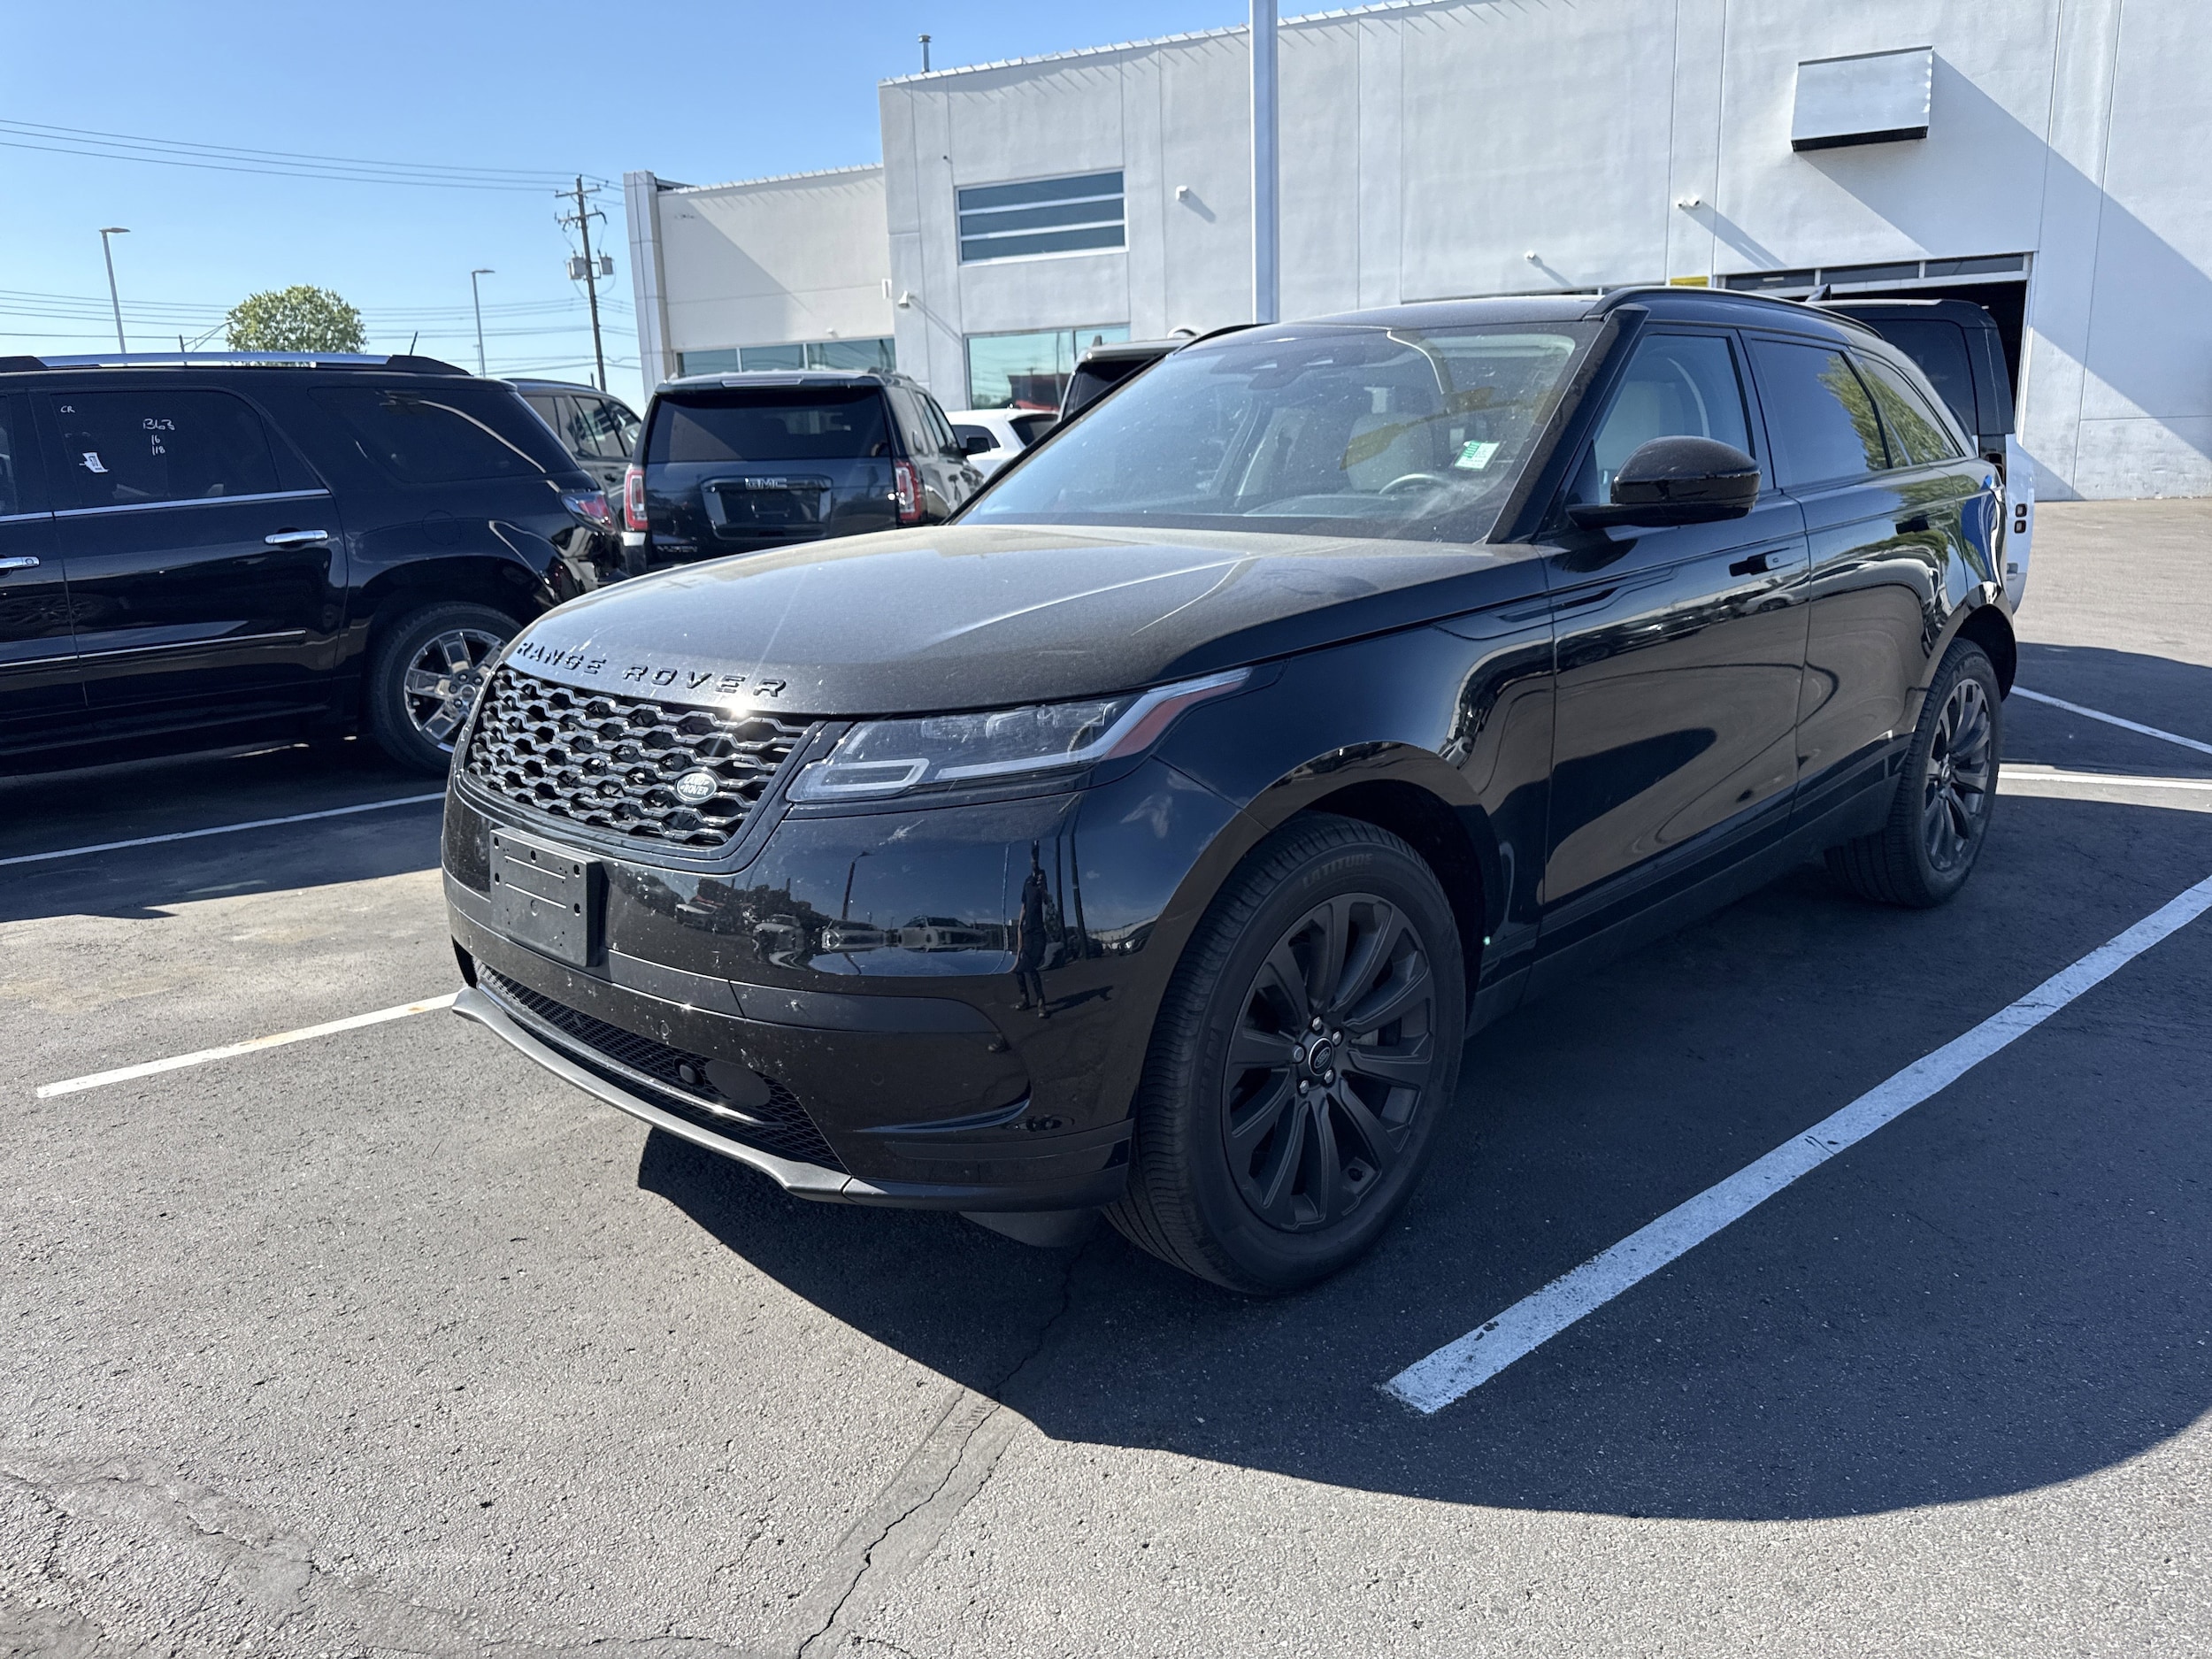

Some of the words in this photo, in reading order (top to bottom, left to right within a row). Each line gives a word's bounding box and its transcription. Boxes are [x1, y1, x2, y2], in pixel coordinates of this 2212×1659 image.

[151, 434, 161, 445] 16
[152, 445, 165, 456] 118
[744, 478, 787, 490] GMC
[517, 641, 607, 675] RANGE
[622, 664, 787, 697] ROVER
[683, 774, 706, 786] LAND
[682, 784, 710, 796] ROVER
[1302, 853, 1373, 890] LATITUDE
